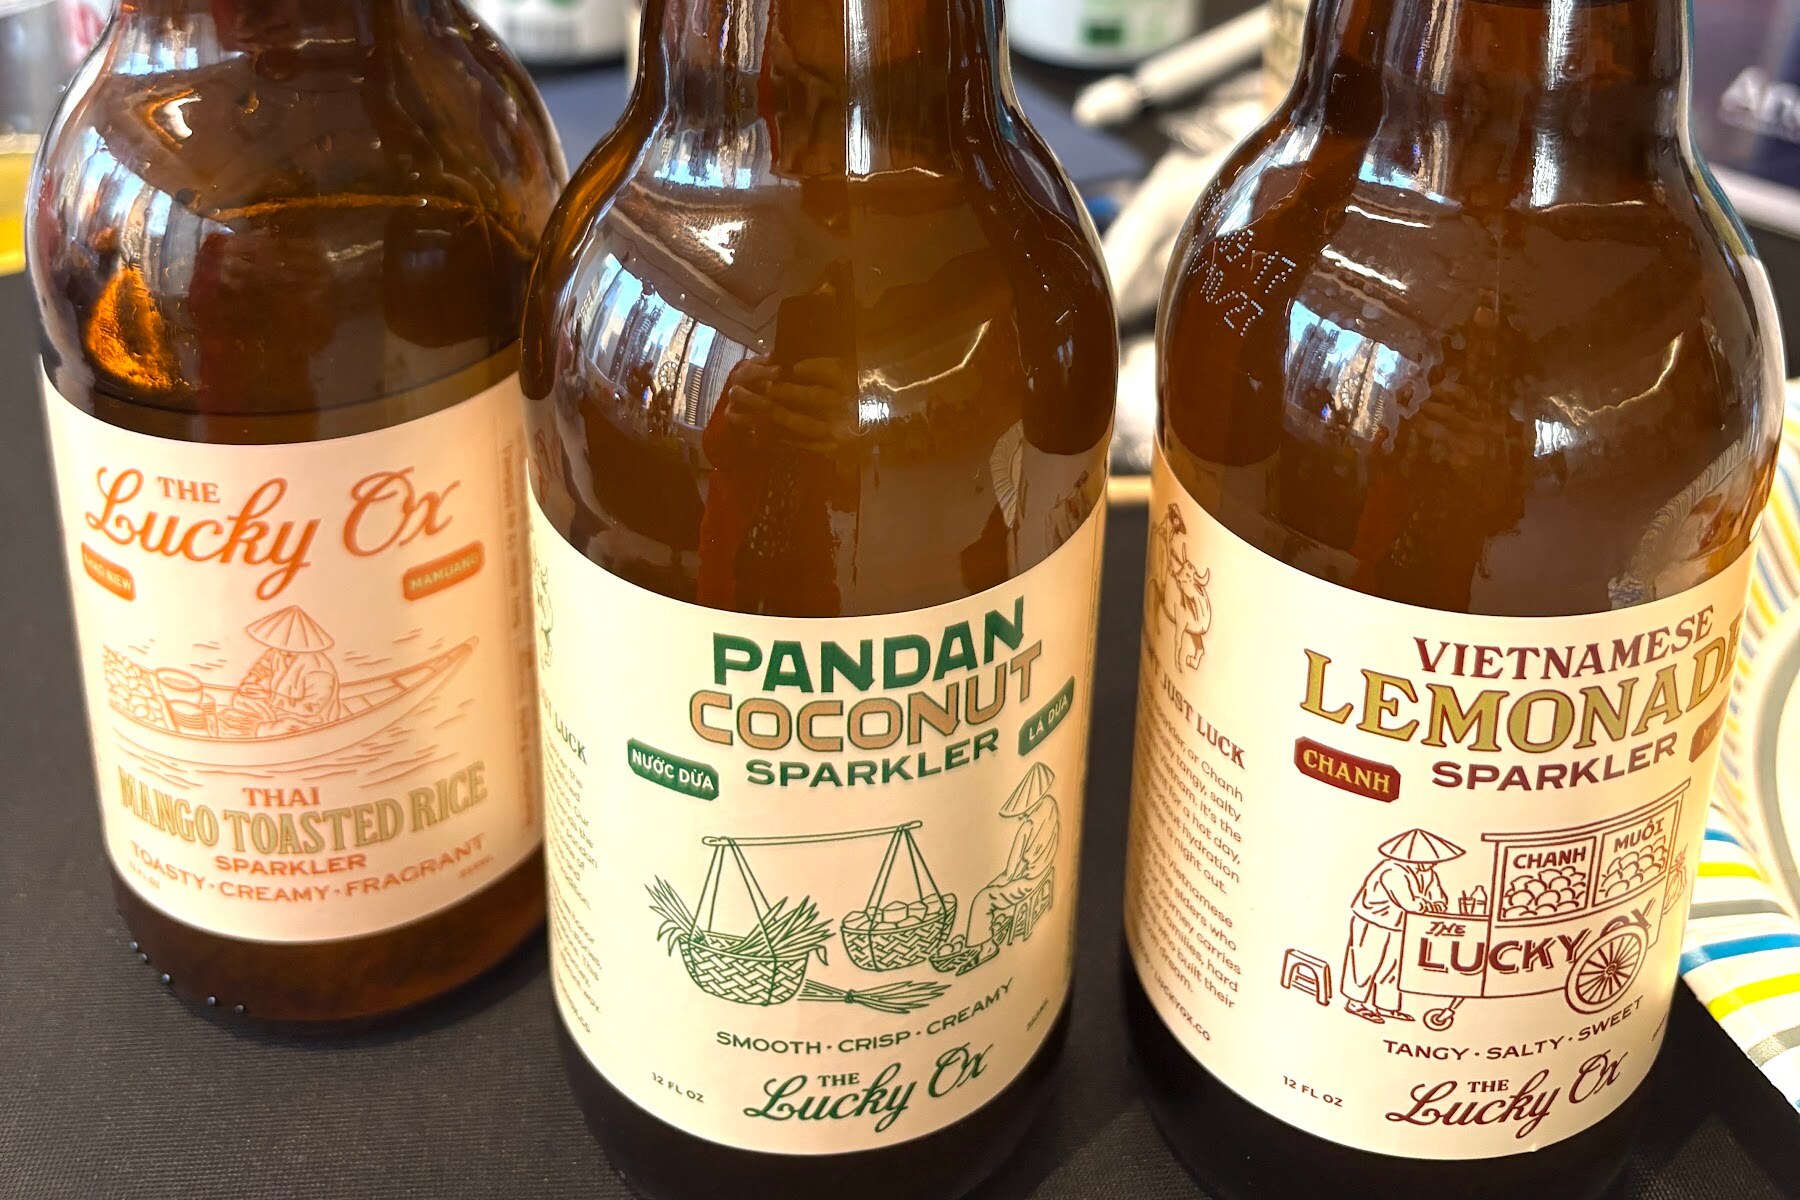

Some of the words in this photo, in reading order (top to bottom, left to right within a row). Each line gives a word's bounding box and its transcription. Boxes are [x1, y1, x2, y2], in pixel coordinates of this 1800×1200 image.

[157, 477, 221, 504] THE
[86, 466, 321, 601] Lucky
[343, 466, 461, 557] Ox
[713, 595, 1024, 693] PANDAN
[1413, 605, 1714, 680] VIETNAMESE
[690, 639, 1042, 752] COCONUT
[555, 711, 588, 766] LUCK
[1161, 673, 1193, 722] JUST
[1197, 712, 1245, 770] LUCK
[632, 749, 675, 779] NƯỚC
[679, 768, 714, 790] DỪA
[745, 728, 999, 787] SPARKLER
[1303, 749, 1390, 795] CHANH
[1432, 731, 1677, 791] SPARKLER
[243, 787, 320, 808] THAI
[1201, 760, 1242, 802] Chanh
[117, 765, 219, 847] MANGO
[224, 798, 404, 855] TOASTED
[410, 761, 488, 832] RICE
[1210, 791, 1241, 822] salty
[1183, 823, 1239, 883] hydration
[1192, 812, 1212, 840] hot
[1213, 837, 1240, 865] day,
[1220, 818, 1241, 842] the
[130, 840, 206, 890] TOASTY
[219, 881, 330, 902] CREAMY
[346, 833, 485, 897] FRAGRANT
[214, 854, 367, 877] SPARKLER
[1174, 836, 1201, 872] night
[1513, 846, 1586, 870] CHANH
[1167, 852, 1233, 928] Vietnamese
[1210, 923, 1237, 951] who
[1417, 928, 1592, 976] LUCKY
[1425, 921, 1466, 937] THE
[1196, 932, 1242, 975] carries
[1207, 958, 1238, 992] hard
[1205, 977, 1235, 1008] their
[716, 1031, 821, 1055] SMOOTH
[838, 1030, 910, 1053] CRISP
[926, 977, 1013, 1035] CREAMY
[1383, 1039, 1470, 1061] TANGY
[1486, 1035, 1564, 1060] SALTY
[1577, 995, 1644, 1041] SWEET
[652, 1072, 663, 1085] 12
[668, 1081, 682, 1095] FL
[686, 1090, 704, 1103] OZ
[744, 1063, 917, 1133] Lucky
[928, 1042, 993, 1098] Ox
[818, 1073, 860, 1087] THE
[1283, 1075, 1297, 1089] 12
[1302, 1084, 1318, 1099] FL
[1323, 1094, 1343, 1107] OZ
[1385, 1069, 1561, 1139] Lucky
[1568, 1050, 1628, 1104] Ox
[1468, 1079, 1509, 1093] THE
